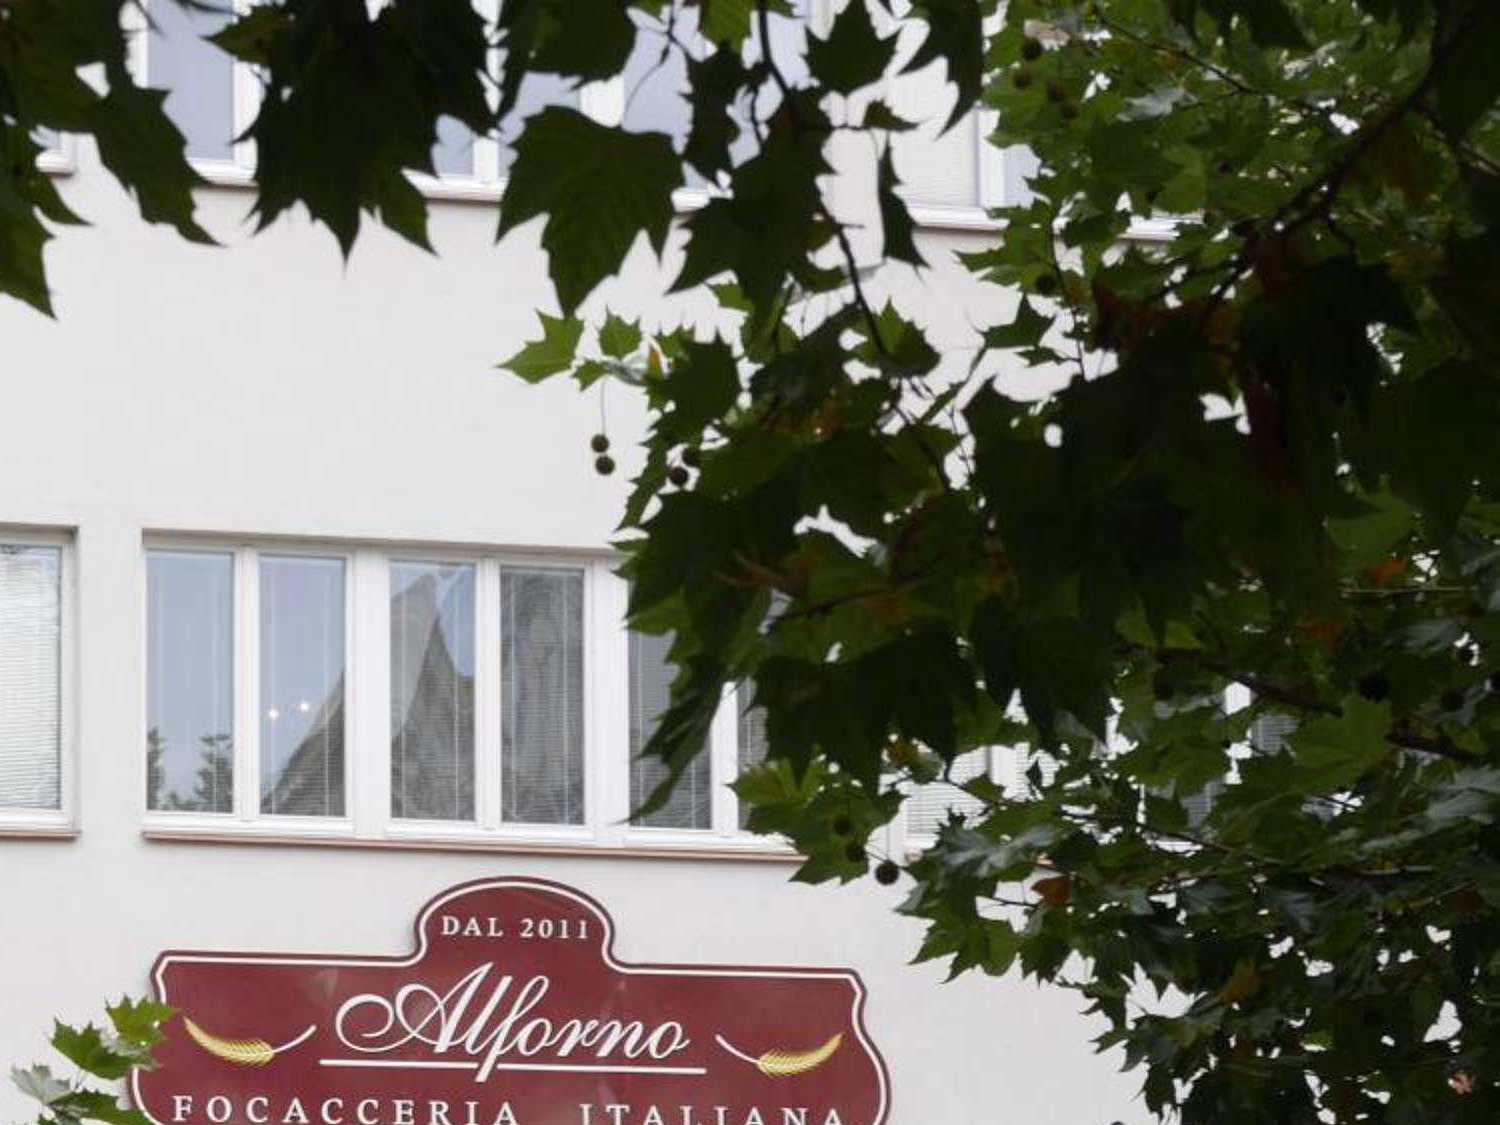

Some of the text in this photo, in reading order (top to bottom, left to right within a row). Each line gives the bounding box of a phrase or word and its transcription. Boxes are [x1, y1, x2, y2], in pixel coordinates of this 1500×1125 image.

[441, 915, 588, 939] DAL 2011
[335, 962, 690, 1082] Alforno
